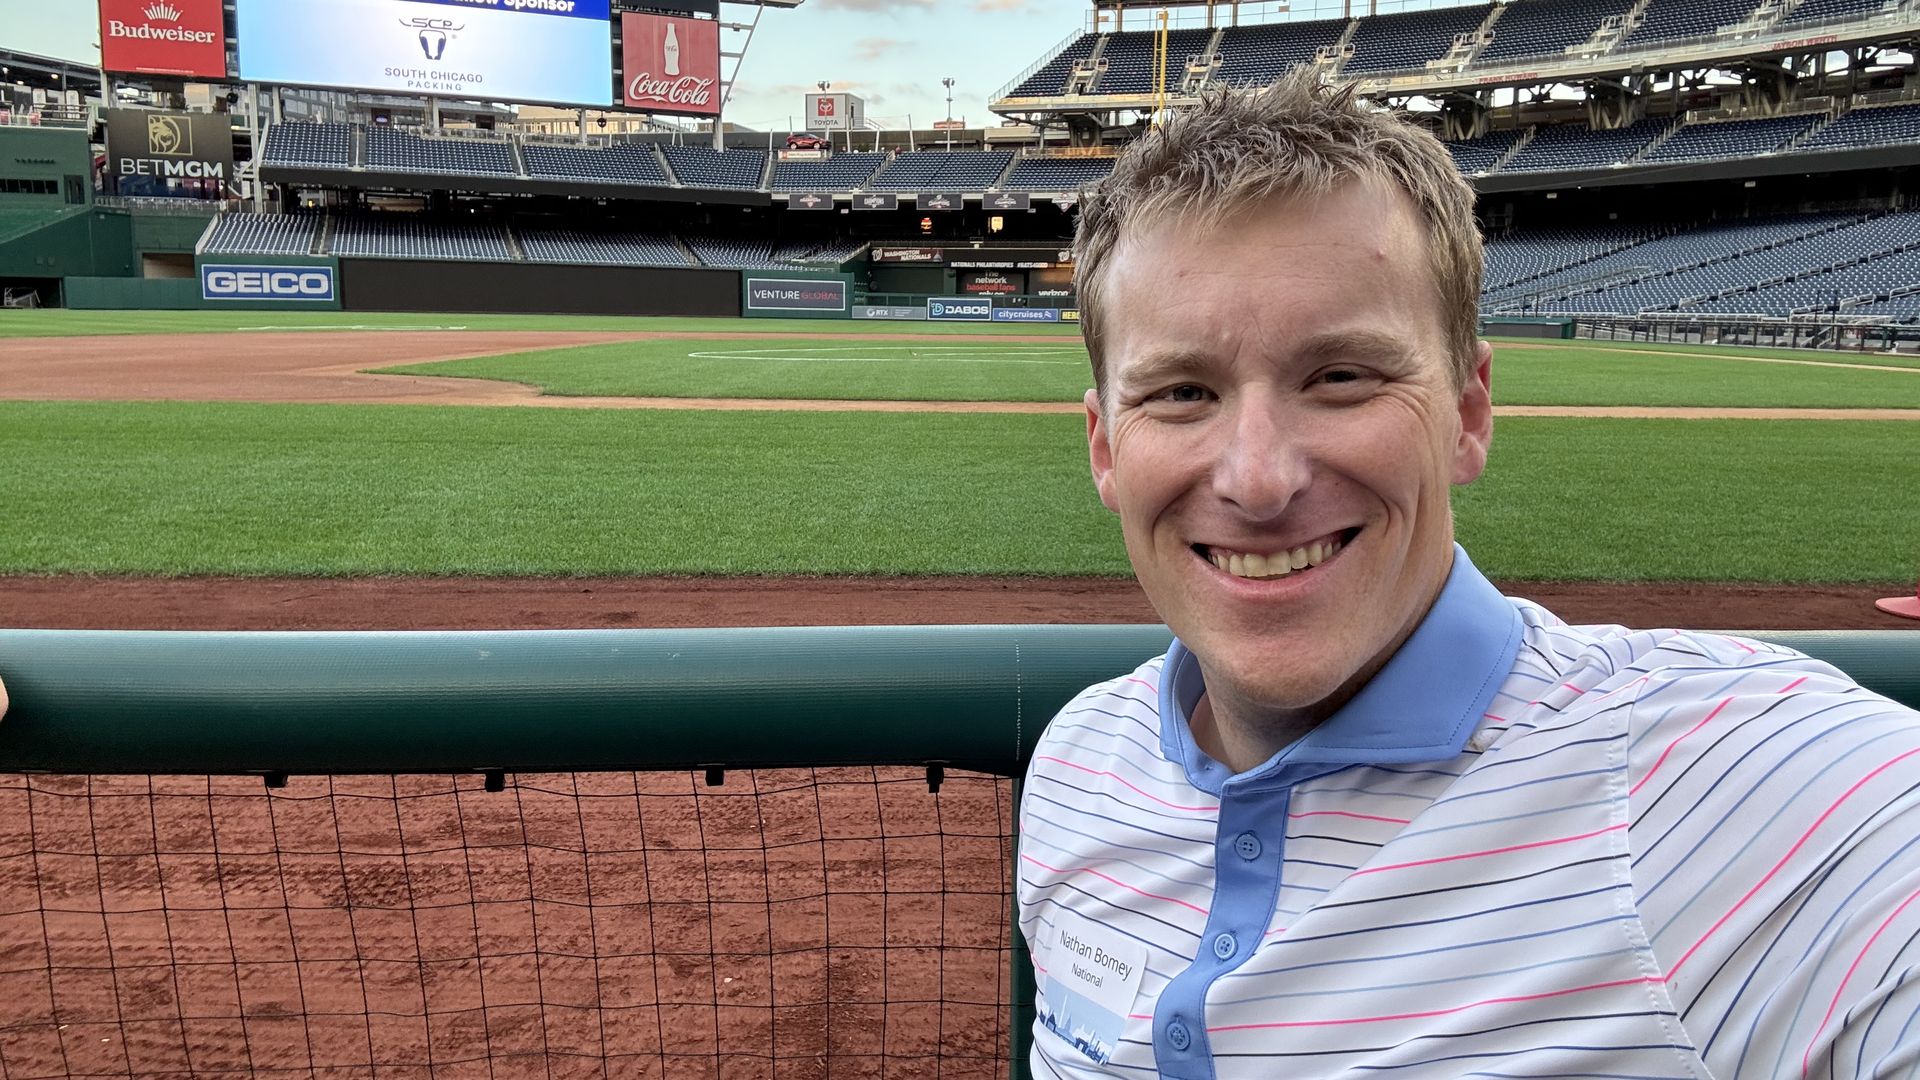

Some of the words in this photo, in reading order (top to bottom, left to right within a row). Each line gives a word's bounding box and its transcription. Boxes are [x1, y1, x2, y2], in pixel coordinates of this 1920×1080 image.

[108, 20, 216, 43] Budweiser
[1772, 40, 1804, 50] JAYSON
[1807, 35, 1838, 46] WERTH
[384, 67, 427, 79] SOUTH
[430, 71, 483, 83] CHICAGO
[407, 80, 462, 91] PACKING
[629, 72, 715, 105] Coca-Cola
[120, 158, 223, 178] BETMGM
[884, 249, 920, 257] WASHINGTON
[901, 253, 932, 261] NATIONALS
[207, 271, 329, 294] GEICO
[975, 276, 1007, 284] network
[966, 283, 998, 291] baseball
[999, 283, 1016, 291] fans
[754, 290, 800, 300] VENTURE
[801, 291, 839, 300] GLOBAL
[1038, 289, 1069, 297] verizon
[875, 309, 889, 317] RTX
[945, 305, 989, 315] DABOS
[998, 310, 1043, 320] citycruises
[1060, 930, 1092, 959] Nathan
[1094, 947, 1132, 981] Bomey
[1071, 963, 1104, 988] National
